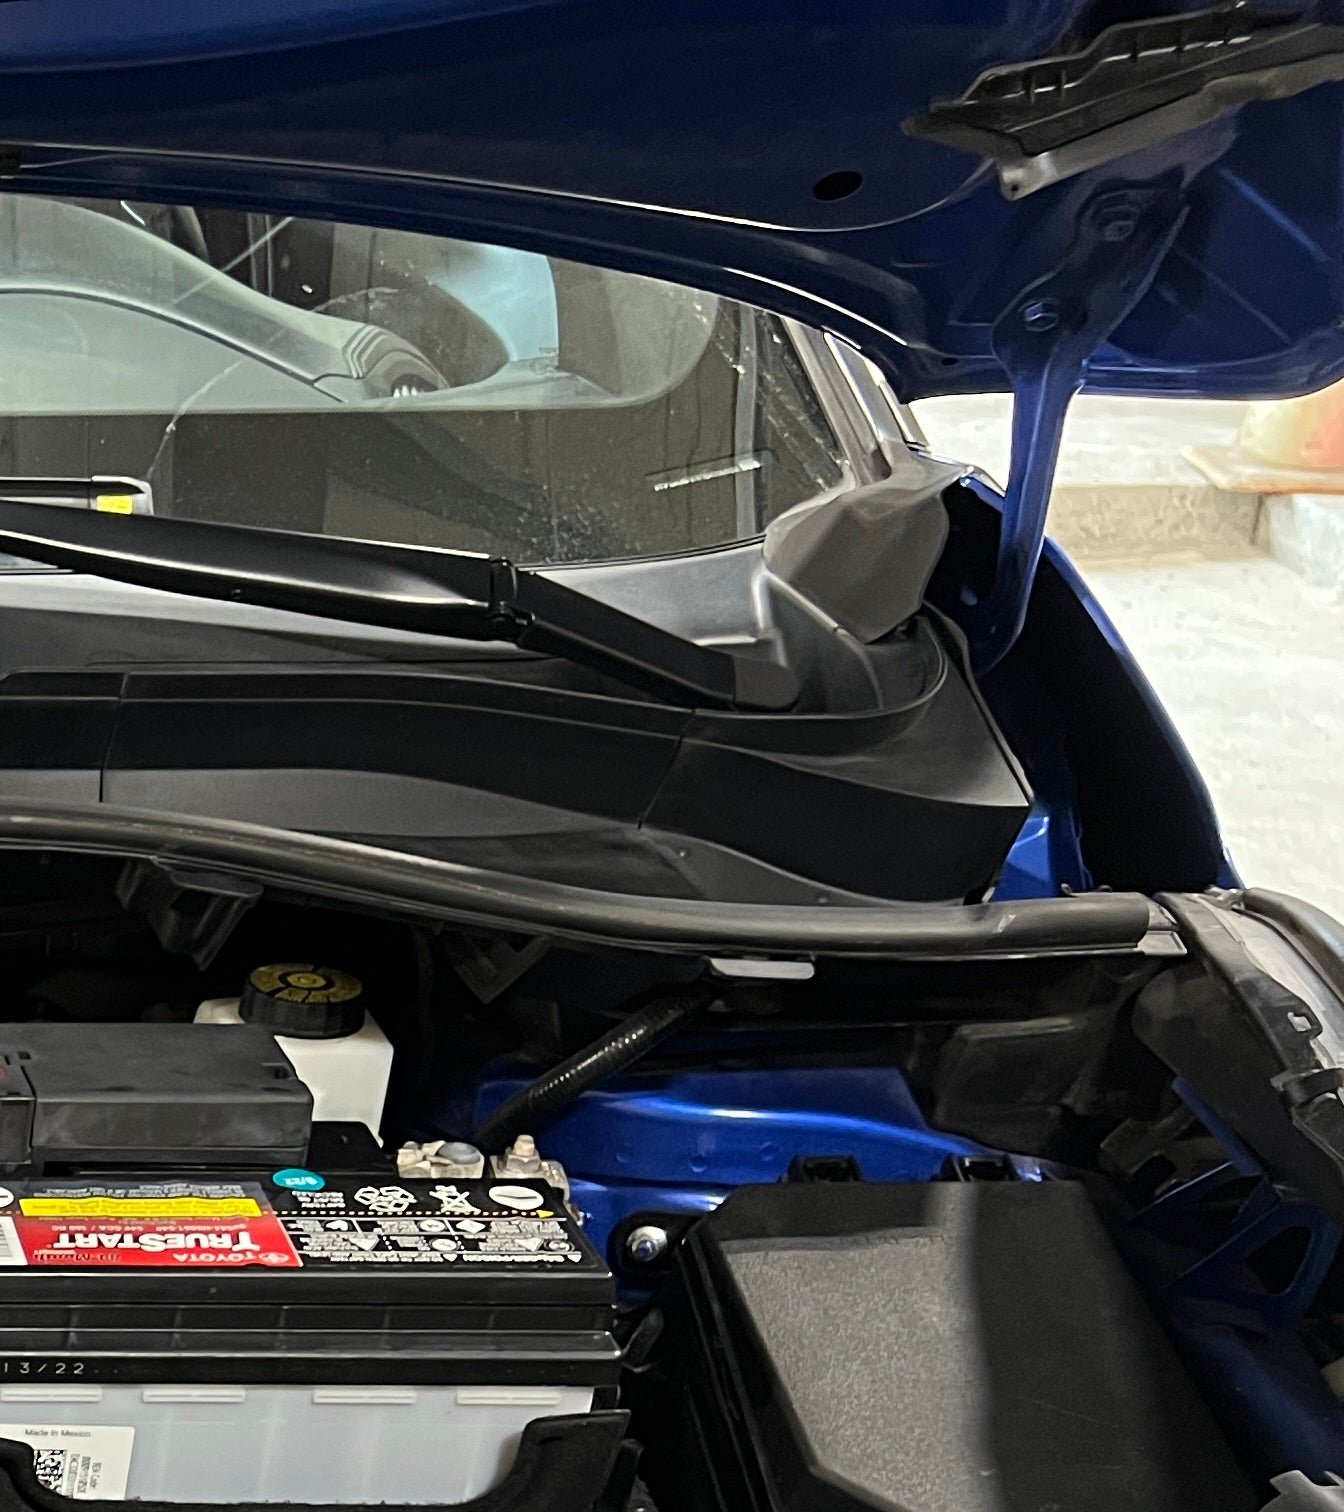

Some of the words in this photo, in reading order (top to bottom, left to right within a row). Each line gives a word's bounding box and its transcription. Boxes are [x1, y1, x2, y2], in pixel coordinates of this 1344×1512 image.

[173, 1252, 260, 1263] TOYOTA
[24, 1428, 49, 1437] Made
[50, 1429, 59, 1437] in
[61, 1429, 92, 1438] Mexico
